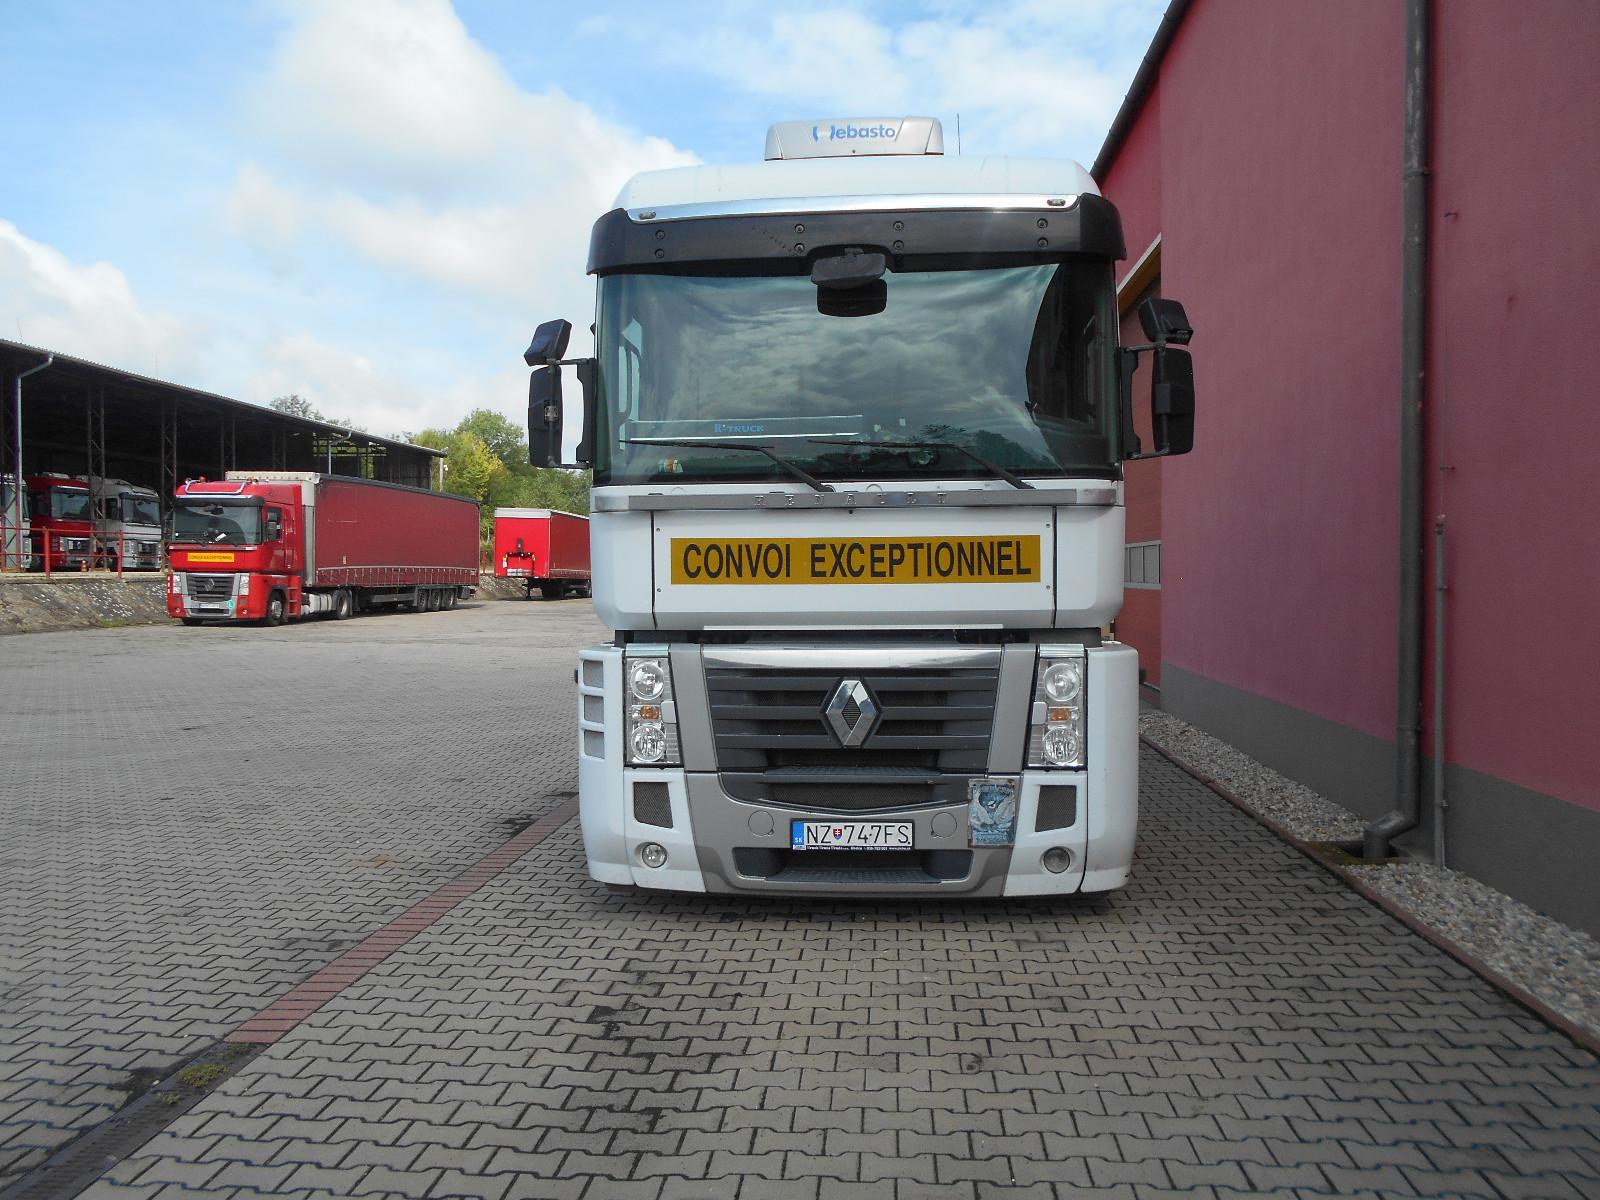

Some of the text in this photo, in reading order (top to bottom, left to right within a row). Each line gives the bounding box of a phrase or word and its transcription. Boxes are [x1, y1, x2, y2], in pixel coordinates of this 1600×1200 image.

[683, 540, 1032, 579] CONVOI EXCEPTIONNEL
[806, 825, 909, 844] NZ 747FS
